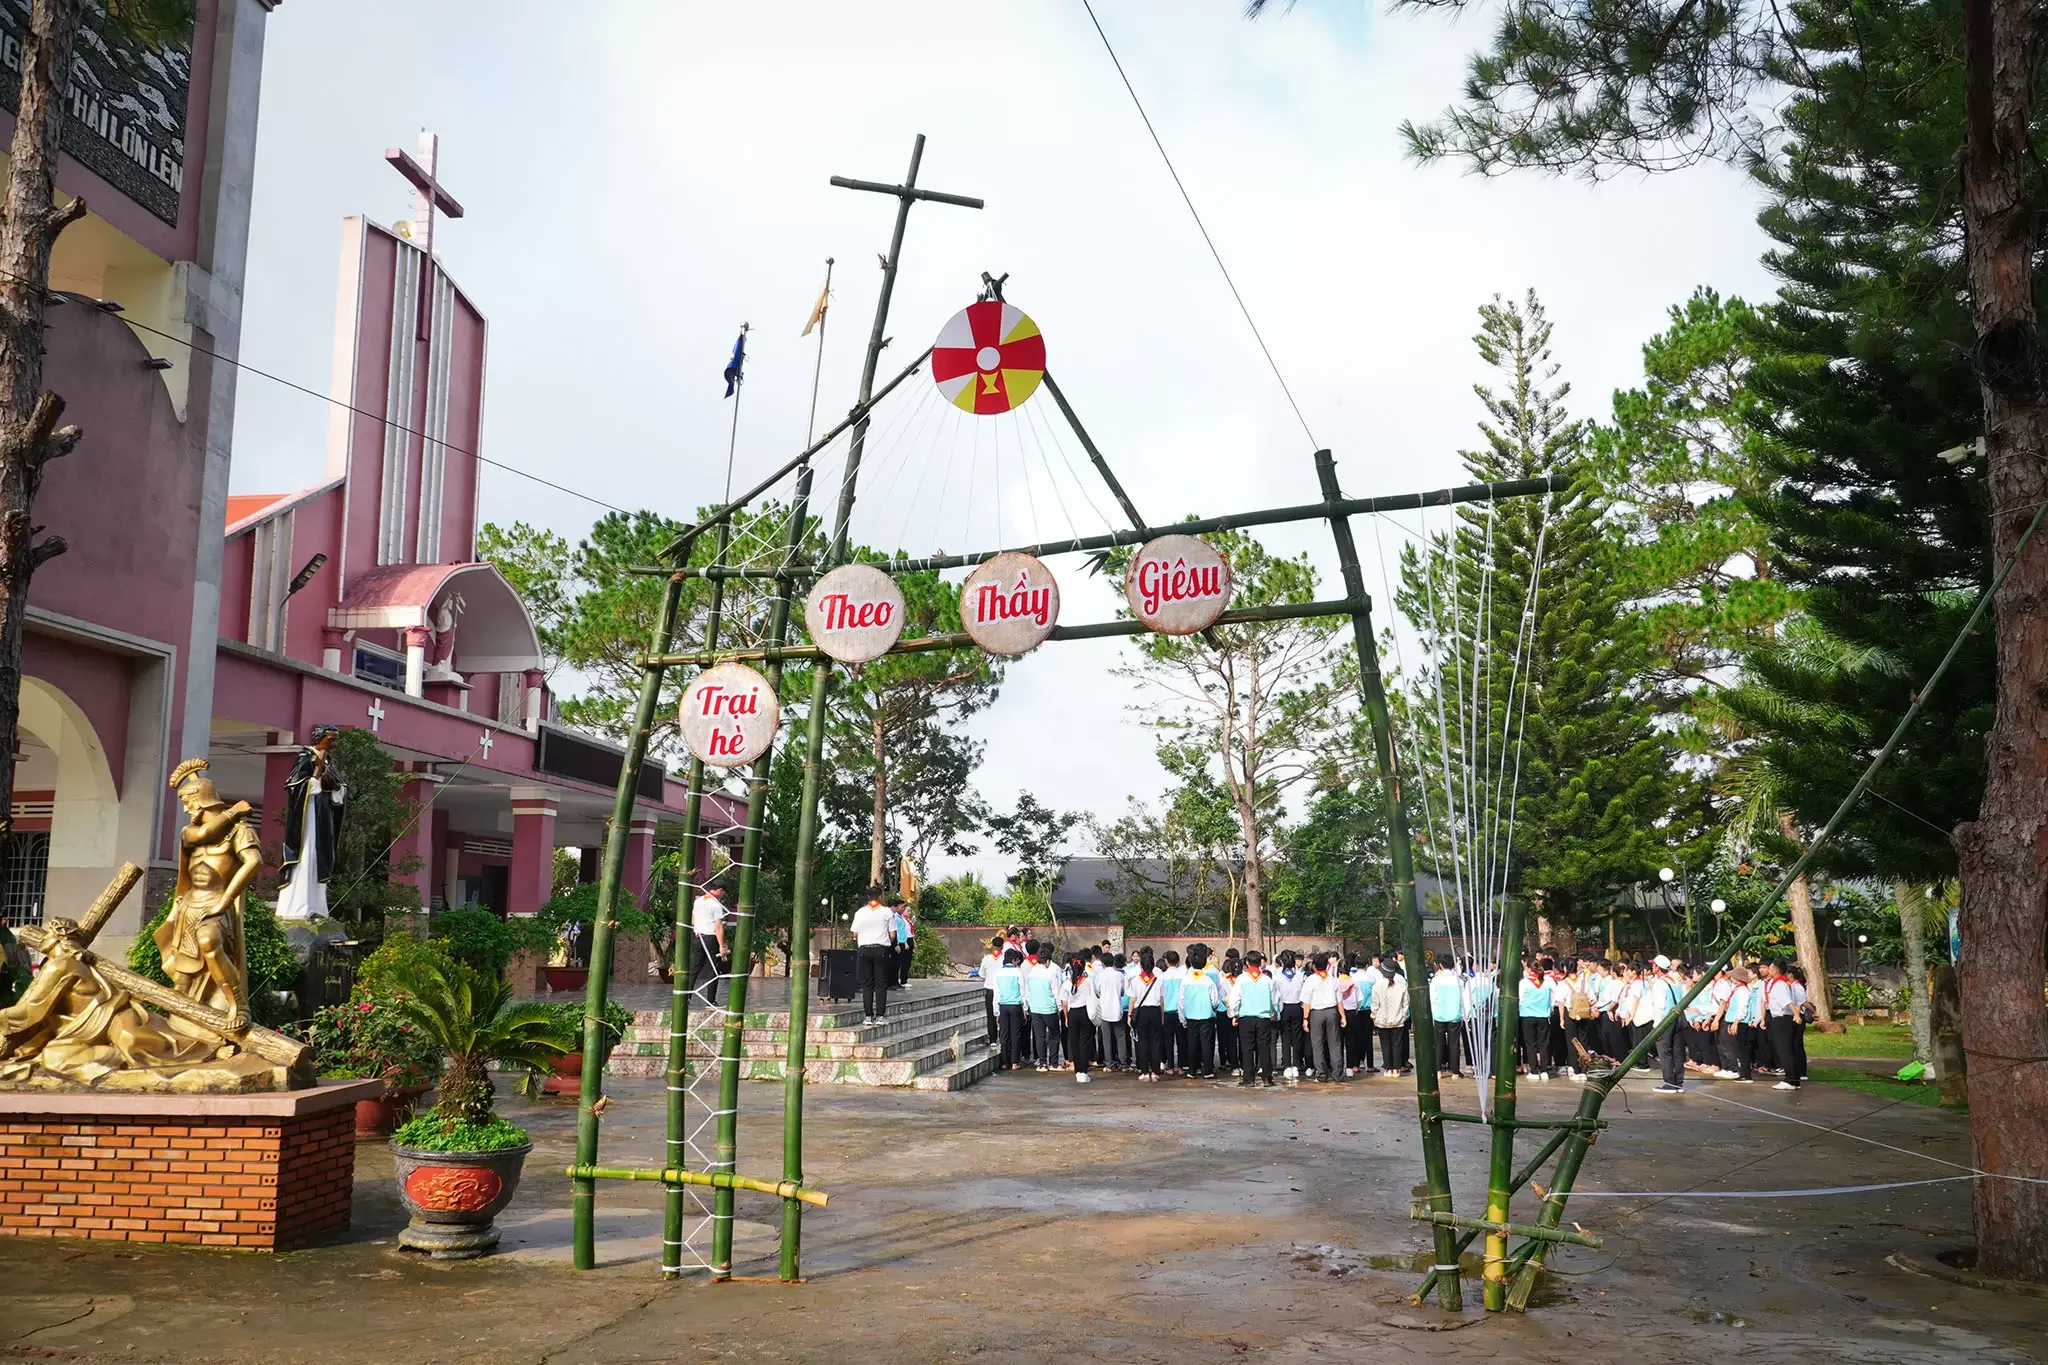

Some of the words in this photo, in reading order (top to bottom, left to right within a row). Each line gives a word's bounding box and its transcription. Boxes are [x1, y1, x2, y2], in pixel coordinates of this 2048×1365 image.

[149, 146, 183, 193] LÊN
[819, 594, 894, 630] Theo
[977, 572, 1049, 625] Thầy
[1139, 557, 1221, 615] Giêsu
[696, 686, 758, 719] Trại
[709, 725, 745, 755] hè
